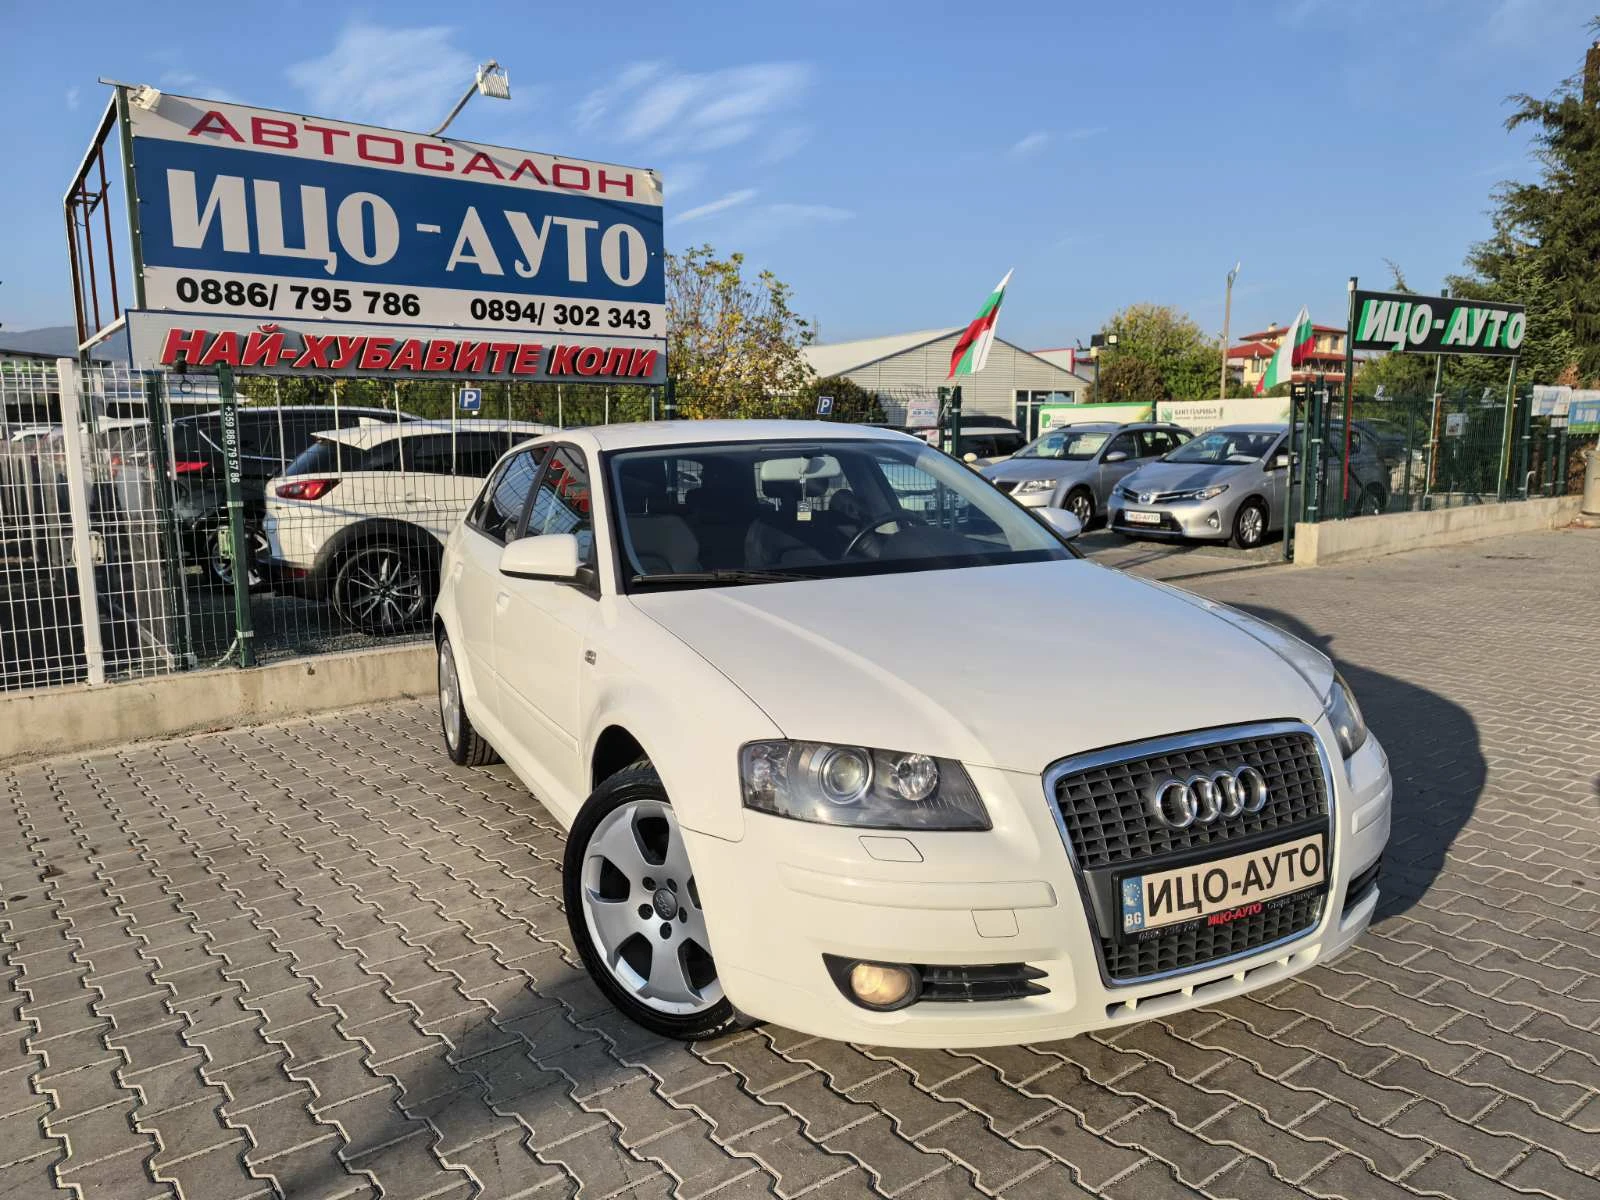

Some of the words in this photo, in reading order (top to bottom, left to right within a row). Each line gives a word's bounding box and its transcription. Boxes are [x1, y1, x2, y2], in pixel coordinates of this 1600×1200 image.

[188, 110, 634, 198] АВТОСАЛОН
[176, 276, 278, 312] 0886/
[289, 285, 352, 315] 795
[362, 290, 420, 317] 786
[470, 298, 544, 327] 0894/
[553, 303, 600, 327] 302
[607, 306, 652, 331] 343
[1356, 299, 1526, 351] ИЦО-АУТО
[161, 323, 544, 375] НАЙ-ХУБАВИТЕ
[547, 343, 658, 379] КОЛИ
[464, 391, 477, 408] P
[820, 399, 830, 413] P
[225, 405, 235, 427] +359
[226, 429, 235, 445] 886
[229, 460, 239, 470] 57
[231, 472, 240, 483] 86
[1147, 843, 1321, 917] ИЦО-АУТО
[1124, 912, 1142, 928] BG
[1207, 902, 1263, 926] ИЦО-АУТО
